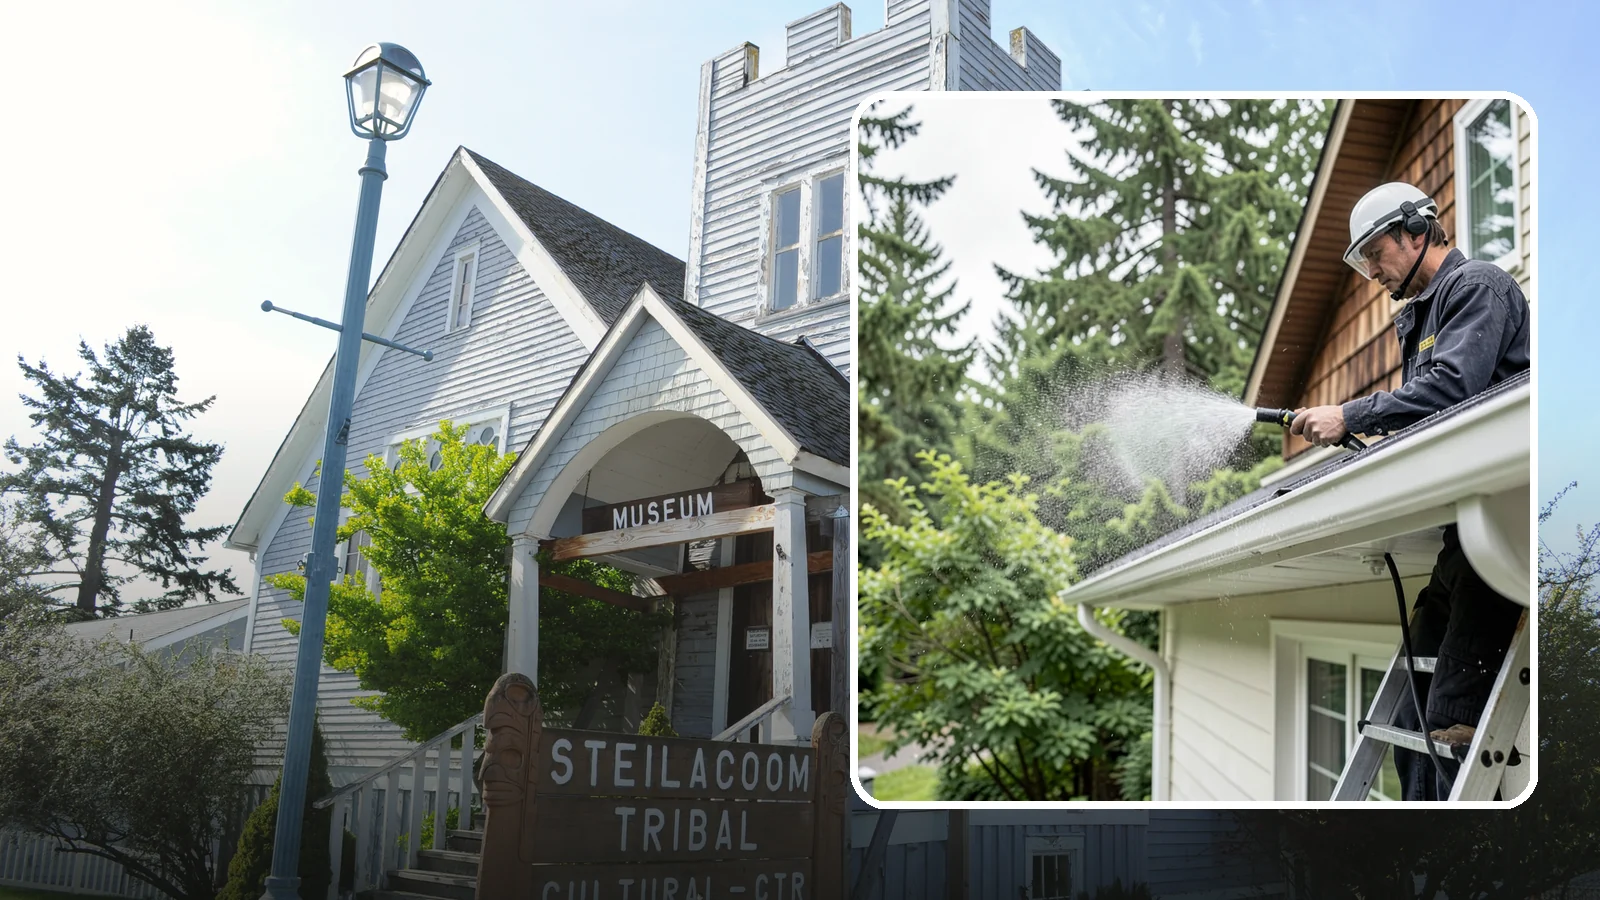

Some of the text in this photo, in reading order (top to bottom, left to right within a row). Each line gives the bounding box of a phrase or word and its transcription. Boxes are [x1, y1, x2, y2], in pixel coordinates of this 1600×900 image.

[613, 492, 713, 530] MUSEUM
[551, 738, 809, 792] STEILACOOM
[615, 807, 757, 851] TRIBAL
